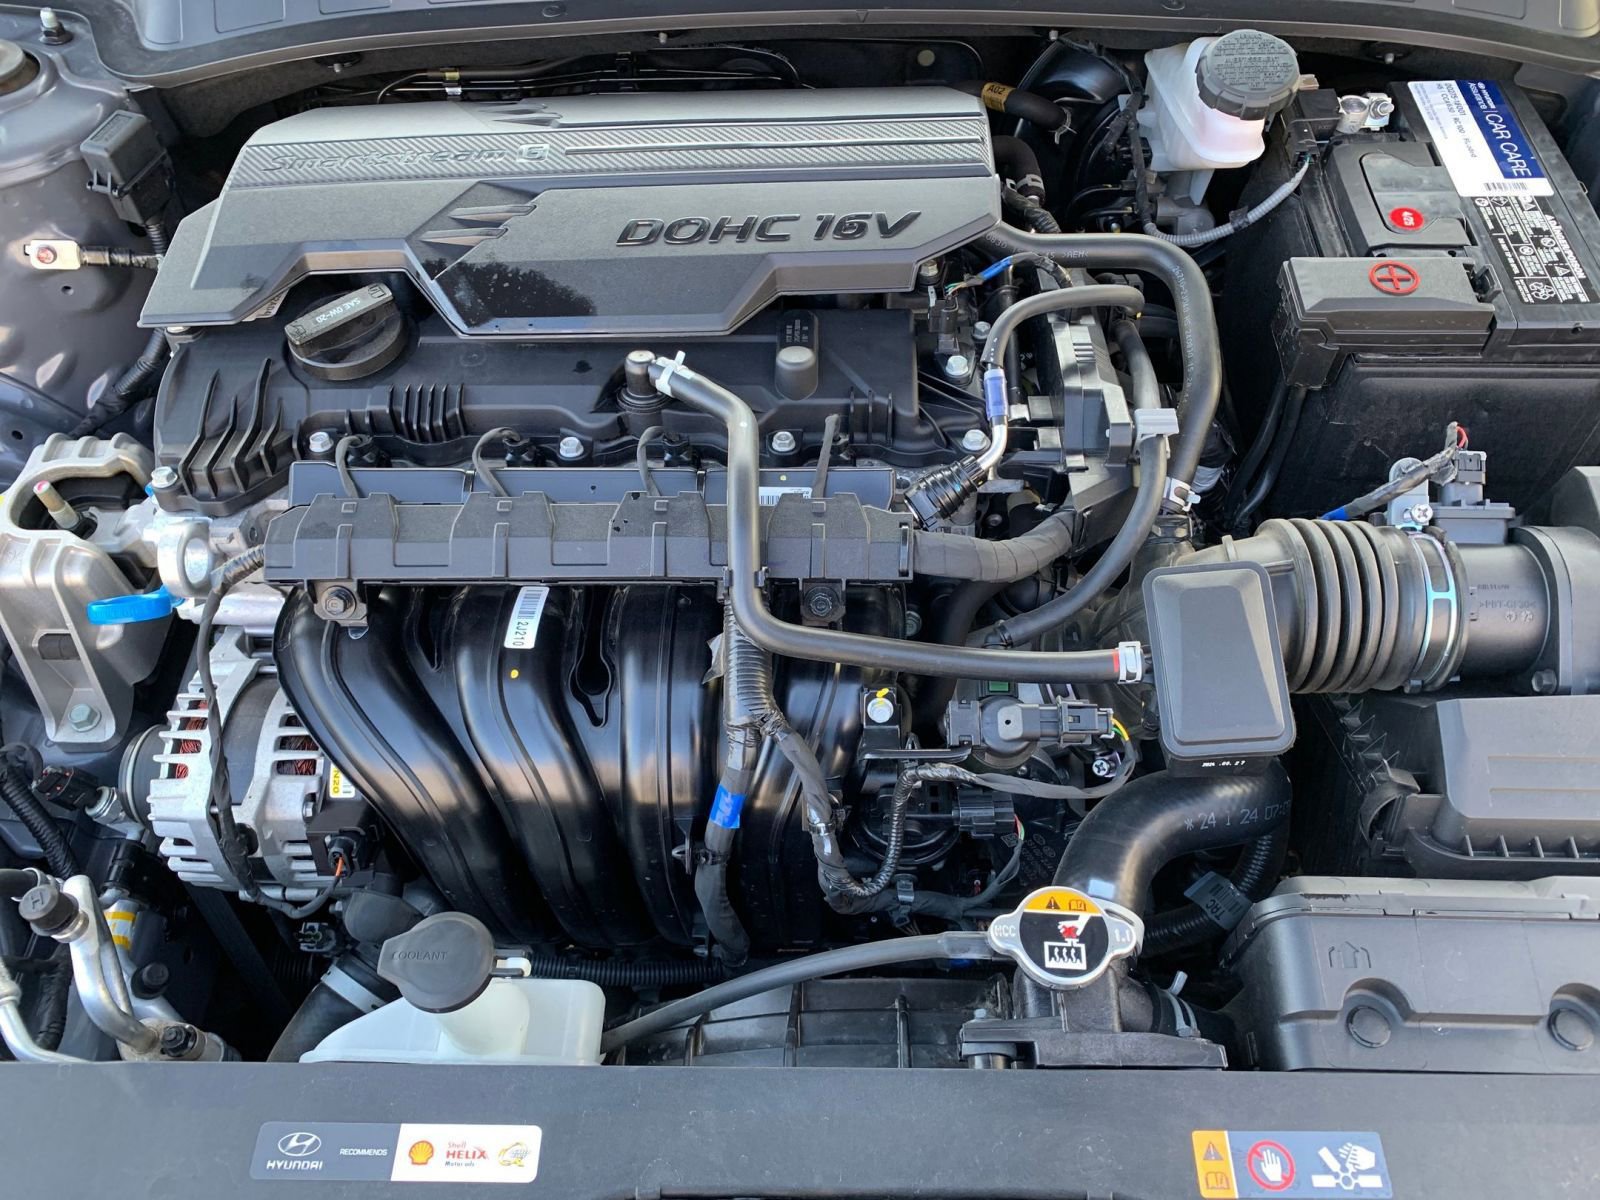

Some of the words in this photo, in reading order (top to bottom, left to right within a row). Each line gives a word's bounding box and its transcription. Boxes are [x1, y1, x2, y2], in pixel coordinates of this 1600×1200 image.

[988, 85, 1005, 94] A02
[1486, 113, 1511, 139] CAR
[1500, 142, 1532, 177] CARE
[263, 149, 506, 171] Smartstream
[616, 214, 801, 246] DOHC
[813, 210, 922, 241] 16V
[347, 297, 361, 309] SAE
[315, 306, 343, 323] 0W-20
[512, 621, 529, 646] 2J210
[1198, 812, 1216, 830] 24
[1240, 808, 1258, 824] 24
[1115, 928, 1130, 942] 1.1
[392, 951, 448, 960] COOLANT
[448, 1141, 466, 1149] Shell
[340, 1148, 387, 1157] RECOMMENDS
[446, 1148, 488, 1160] HELIX
[266, 1160, 323, 1171] HYUNDAI
